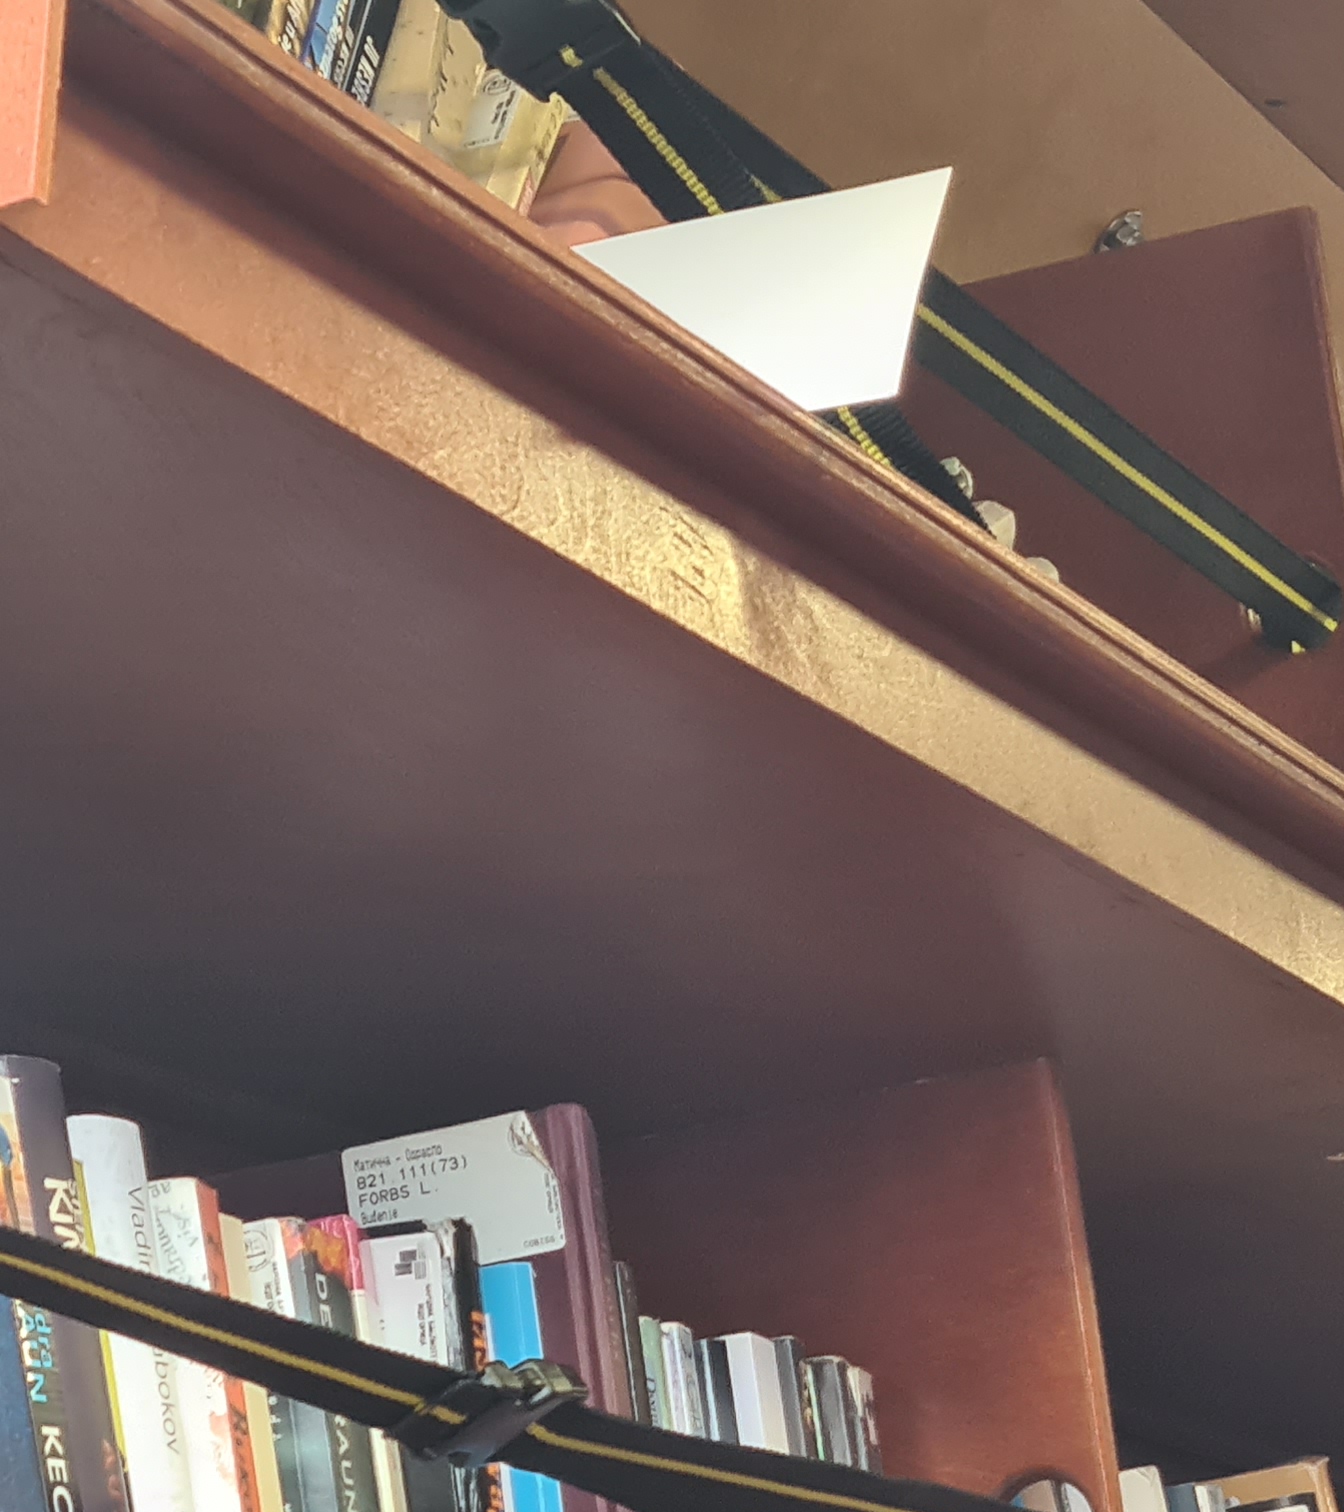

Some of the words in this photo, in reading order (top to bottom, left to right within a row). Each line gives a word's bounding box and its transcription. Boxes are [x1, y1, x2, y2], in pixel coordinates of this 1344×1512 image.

[43, 1177, 80, 1248] KIN
[359, 1185, 410, 1208] FORBS
[128, 1187, 152, 1266] Vladi
[152, 1347, 180, 1455] bokov
[314, 1272, 333, 1329] DE
[14, 1299, 47, 1404] AUN
[33, 1306, 53, 1369] dra
